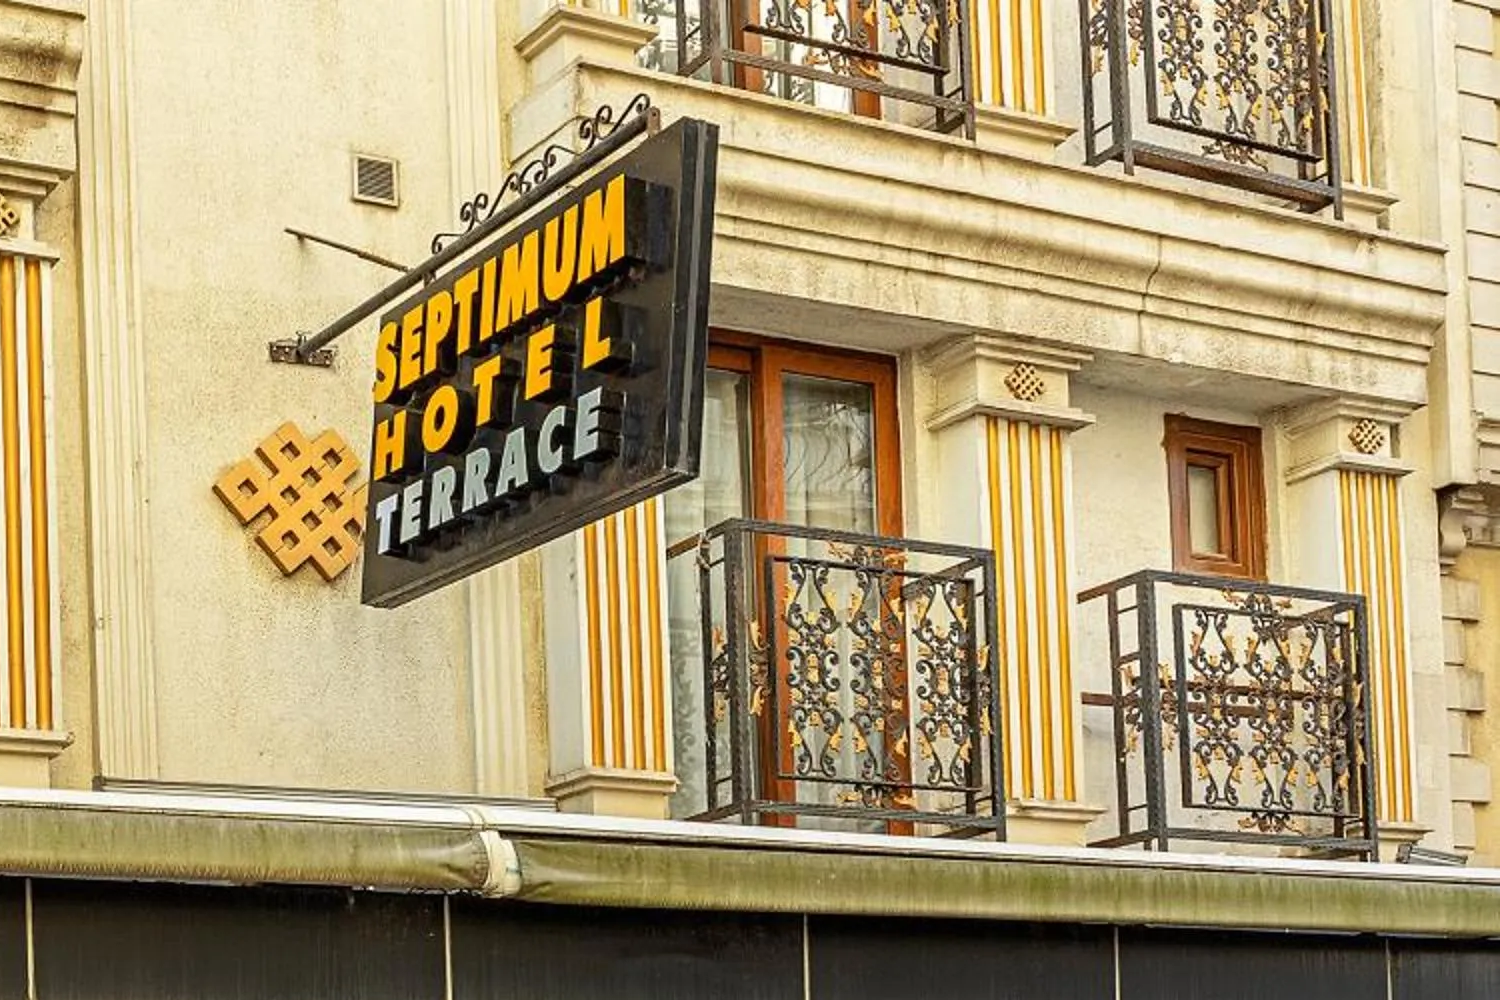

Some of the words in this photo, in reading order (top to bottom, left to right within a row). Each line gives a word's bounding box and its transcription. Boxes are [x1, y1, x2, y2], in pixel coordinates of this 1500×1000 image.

[373, 172, 626, 404] SEPTIMUM
[373, 295, 611, 482] HOTEL
[375, 384, 604, 556] TERRACE
